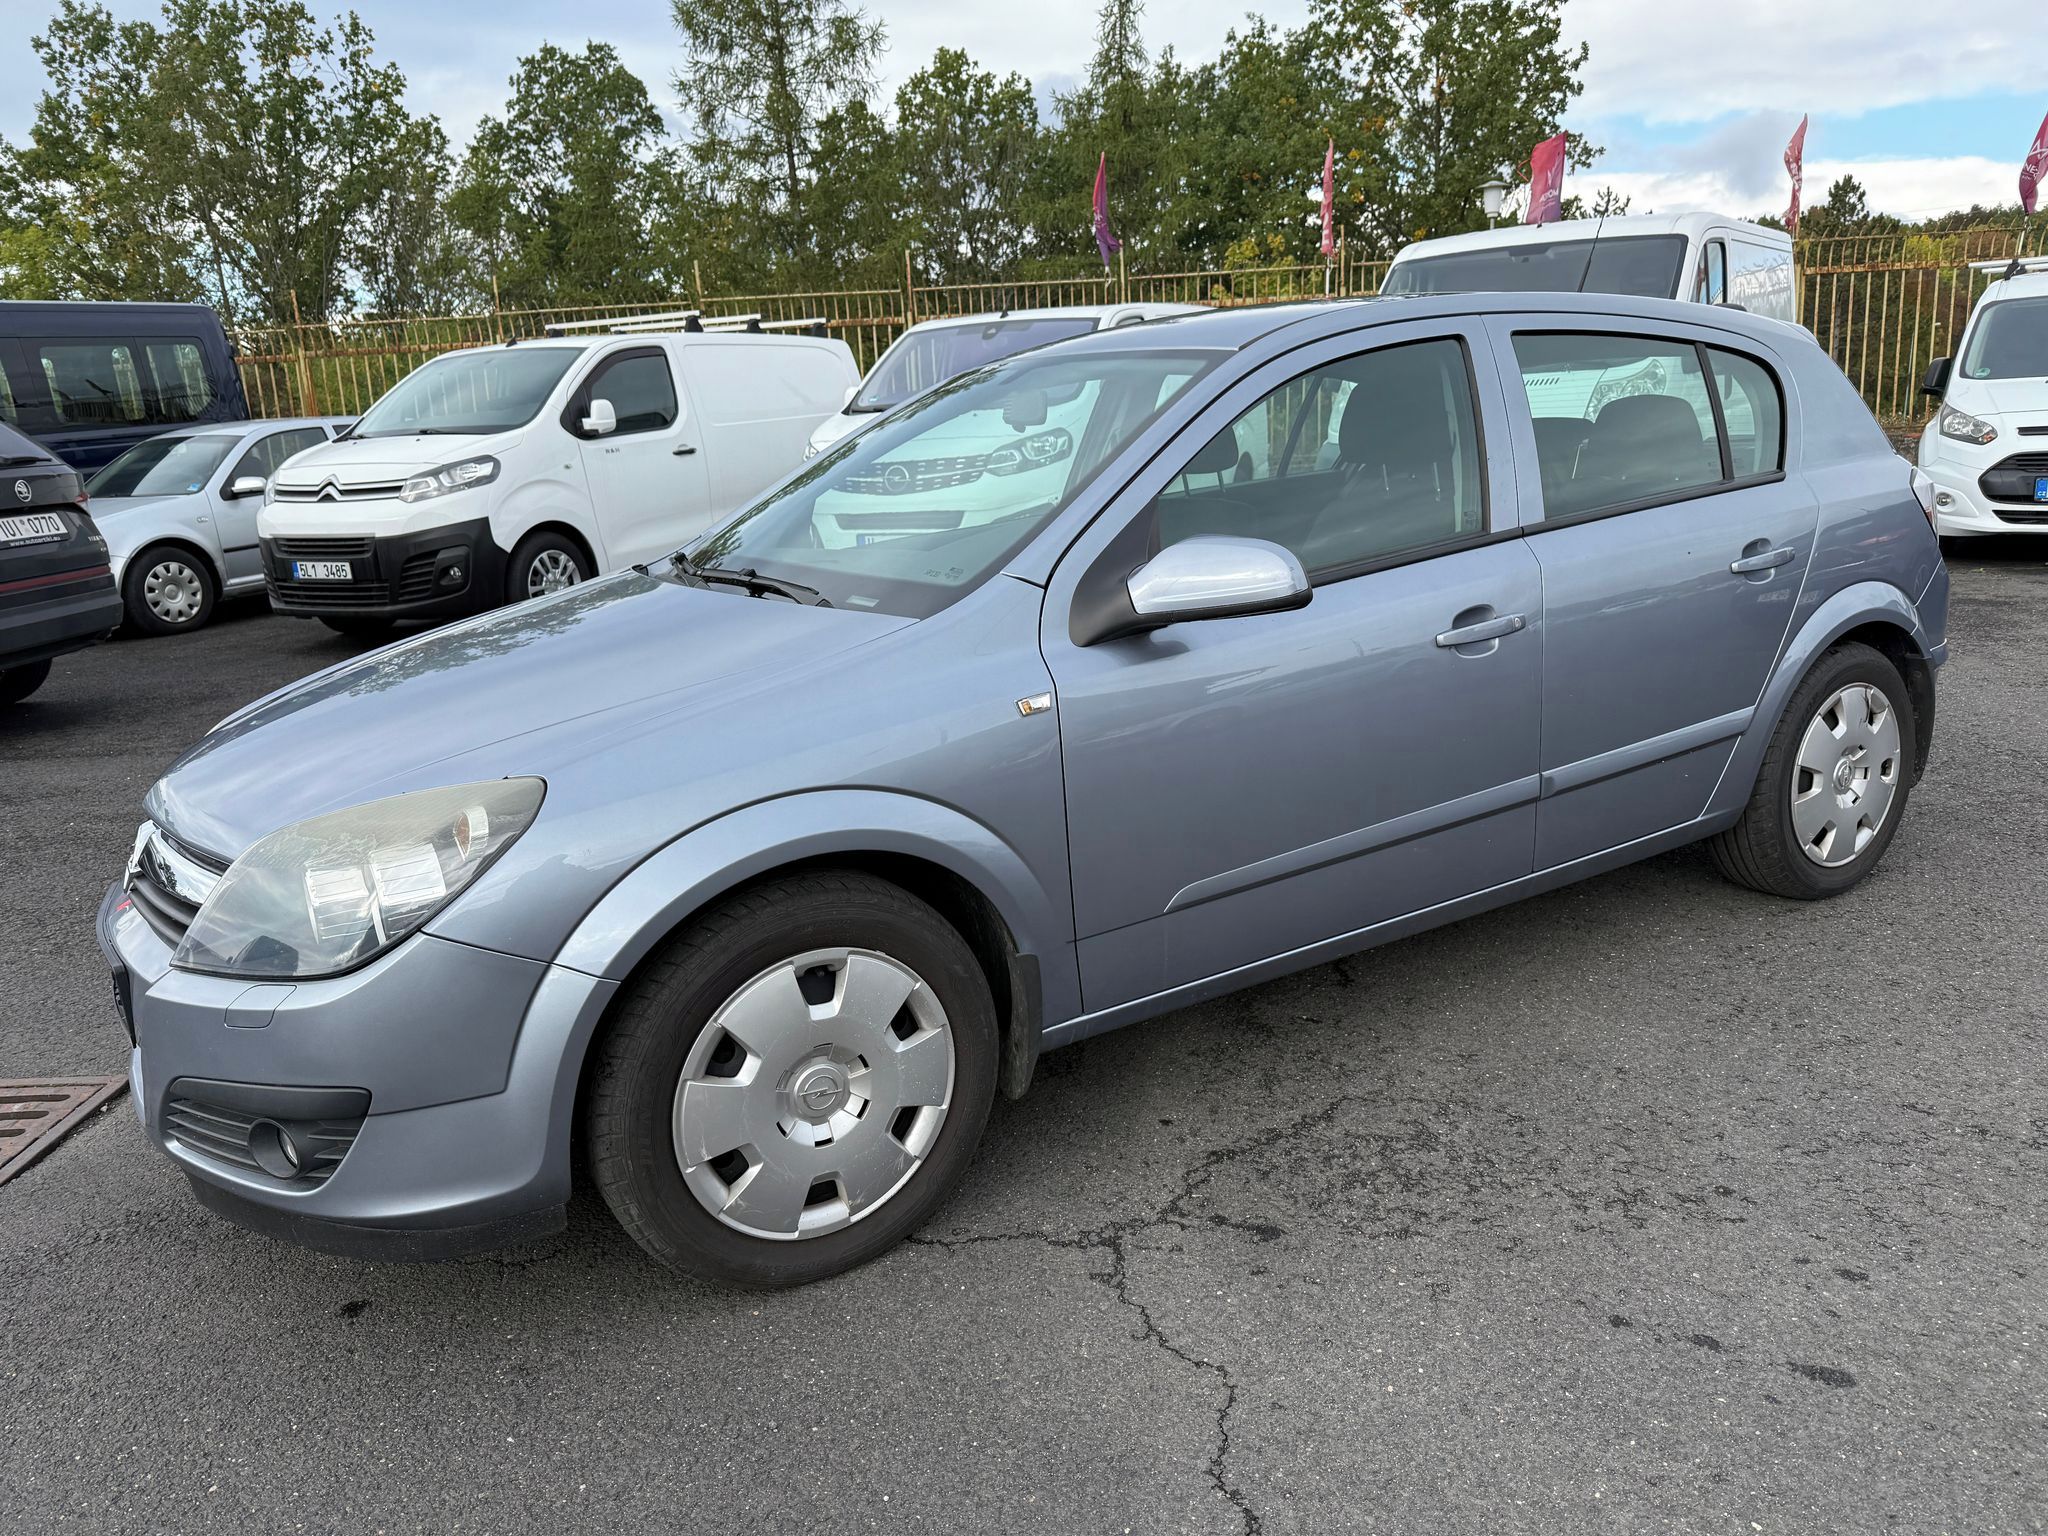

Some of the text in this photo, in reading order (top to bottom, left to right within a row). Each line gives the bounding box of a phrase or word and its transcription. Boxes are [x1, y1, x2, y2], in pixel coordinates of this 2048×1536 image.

[27, 516, 60, 533] 0770
[300, 563, 348, 578] 5L1 3485
